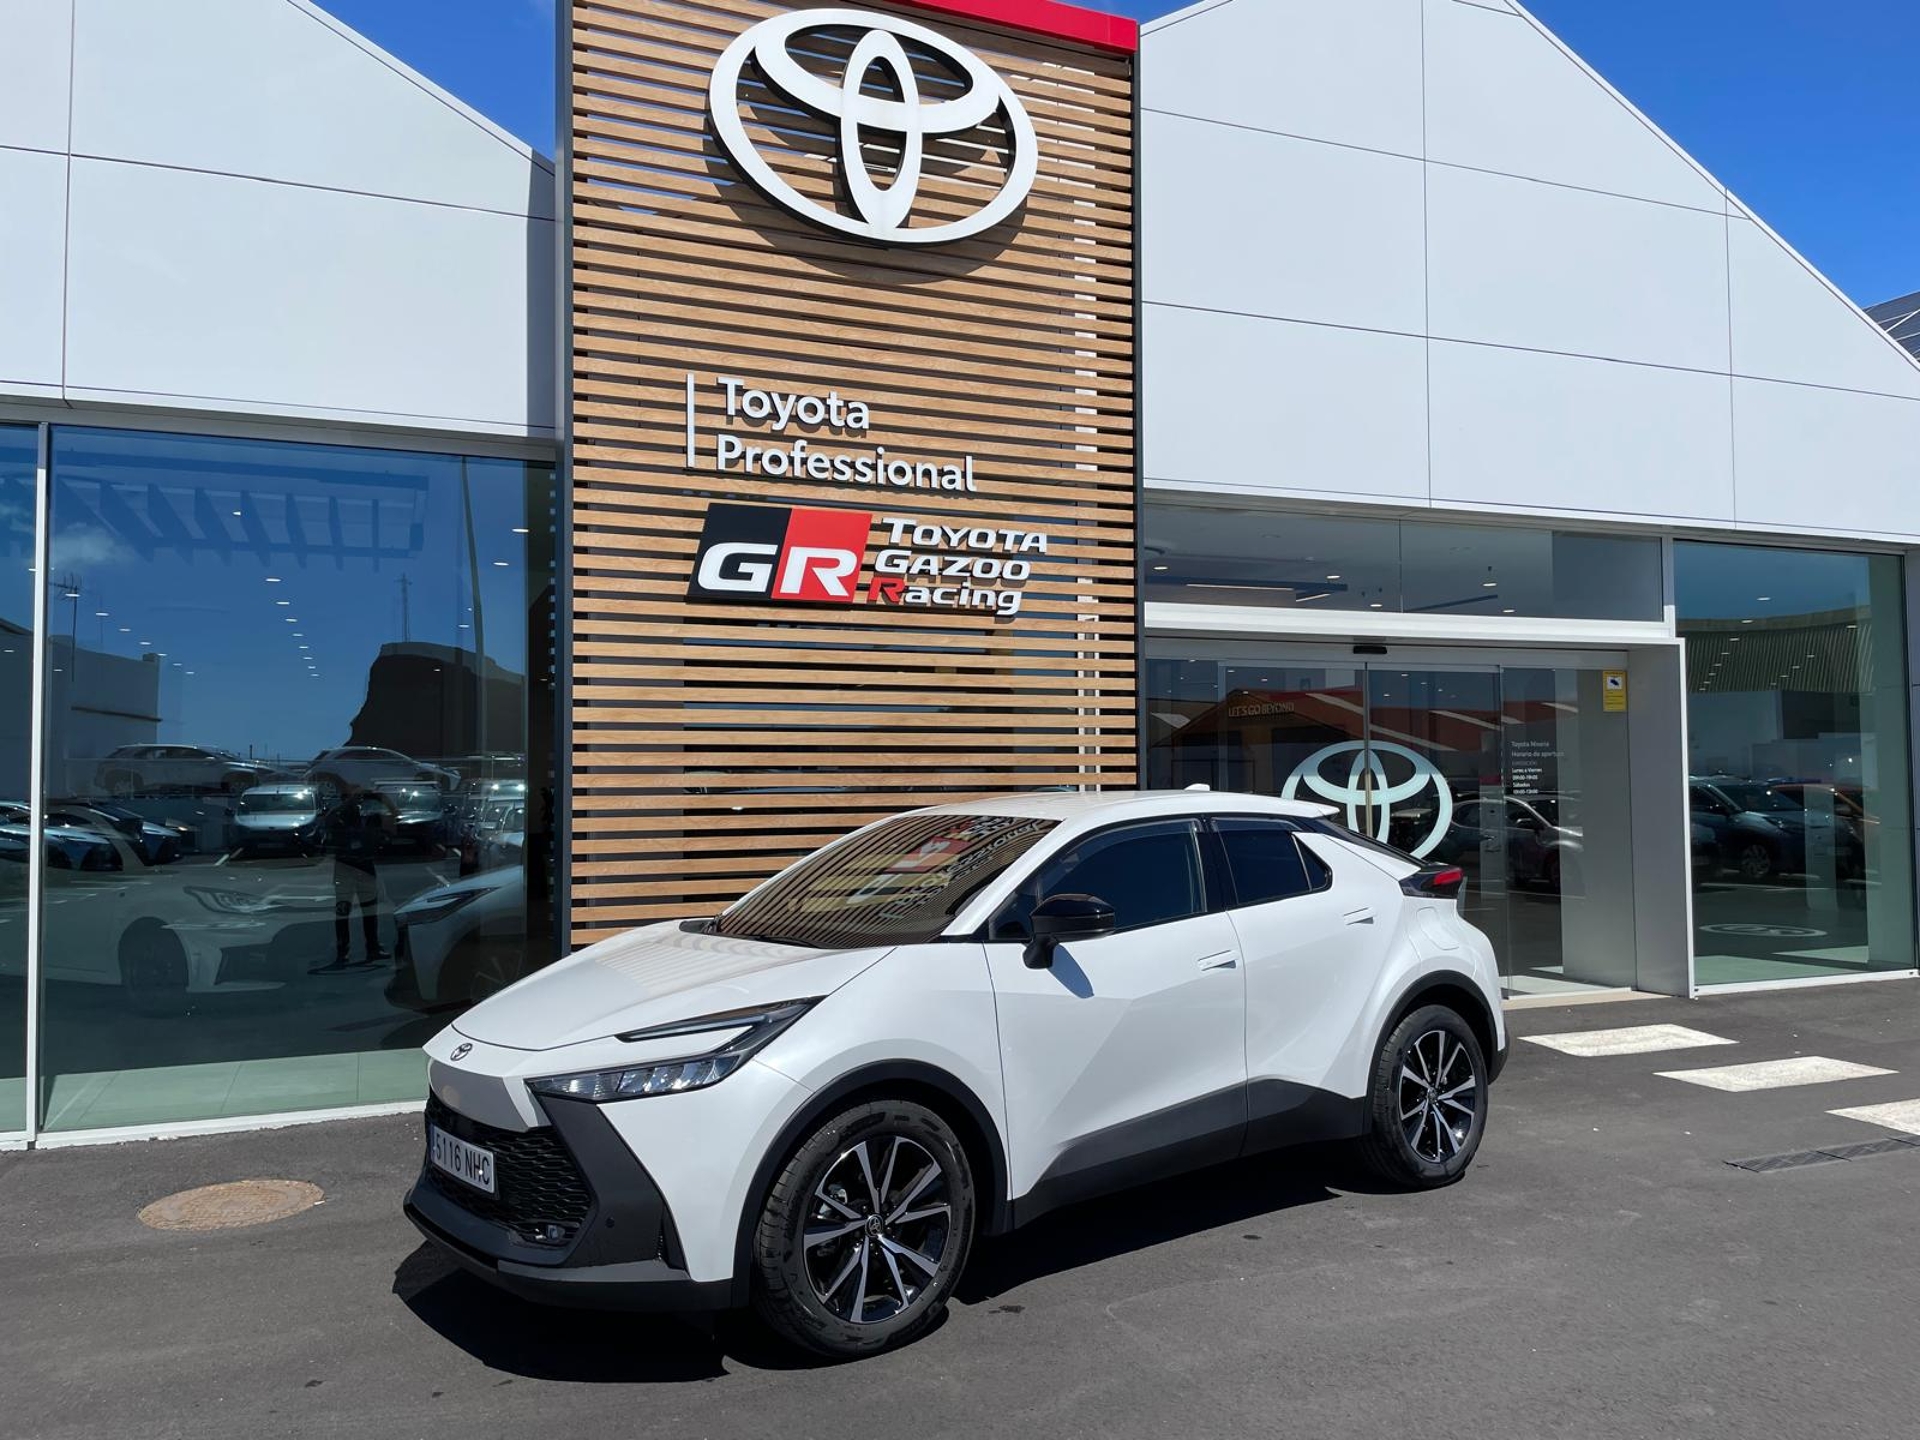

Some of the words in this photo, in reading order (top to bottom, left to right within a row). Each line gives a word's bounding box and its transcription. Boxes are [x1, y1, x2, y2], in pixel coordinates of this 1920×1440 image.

[717, 377, 870, 431] Toyota
[717, 434, 977, 492] Professional
[882, 517, 1048, 553] TOYOTA
[697, 542, 858, 597] GR
[875, 549, 1032, 581] GAZOO
[868, 577, 1023, 616] Racing
[1248, 704, 1261, 715] GO
[1262, 701, 1295, 714] BEYOND
[436, 1132, 461, 1172] 5116
[465, 1148, 490, 1185] NHC
